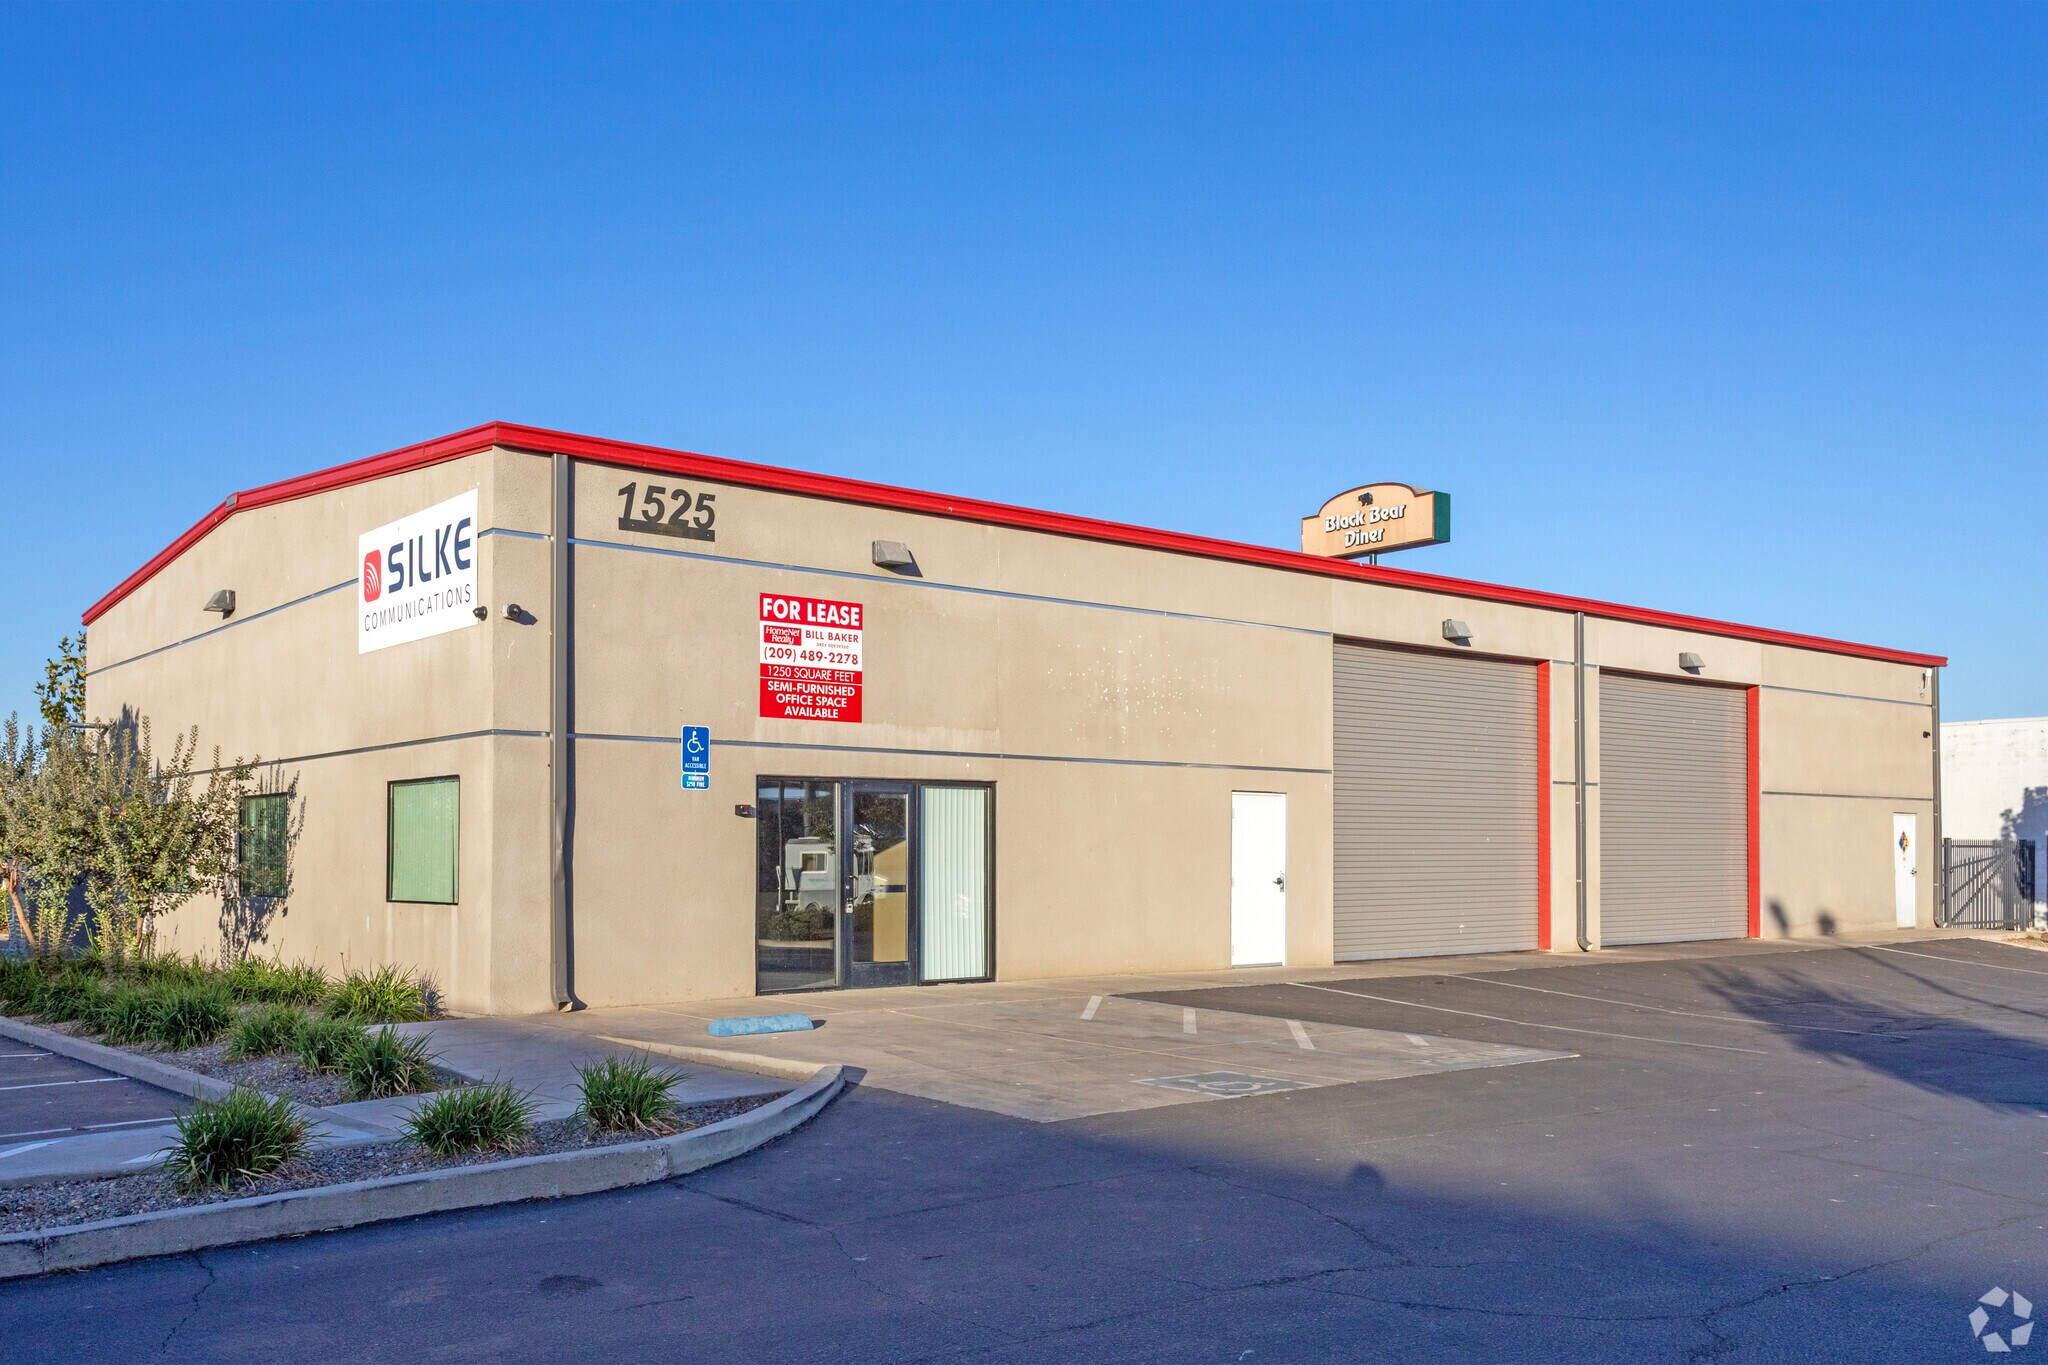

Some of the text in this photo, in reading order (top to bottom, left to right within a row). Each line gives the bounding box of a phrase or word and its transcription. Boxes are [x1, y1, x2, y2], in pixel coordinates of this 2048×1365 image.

[618, 482, 716, 530] 1525
[1325, 504, 1407, 533] Black Bear
[1344, 528, 1385, 548] Diner
[388, 517, 471, 594] SILKE
[364, 583, 471, 632] COMMUNICATIONS
[763, 597, 860, 626] FOR LEASE
[765, 626, 800, 637] HomeNet
[771, 634, 794, 645] Realty
[805, 629, 859, 643] BILL BAKER
[764, 646, 858, 665] (209) 489-2278
[768, 665, 855, 682] 1250 SQUARE FEET
[767, 680, 855, 697] SEMI-FURNISHED
[776, 693, 847, 708] OFFICE SPACE
[784, 706, 839, 719] AVAILABLE
